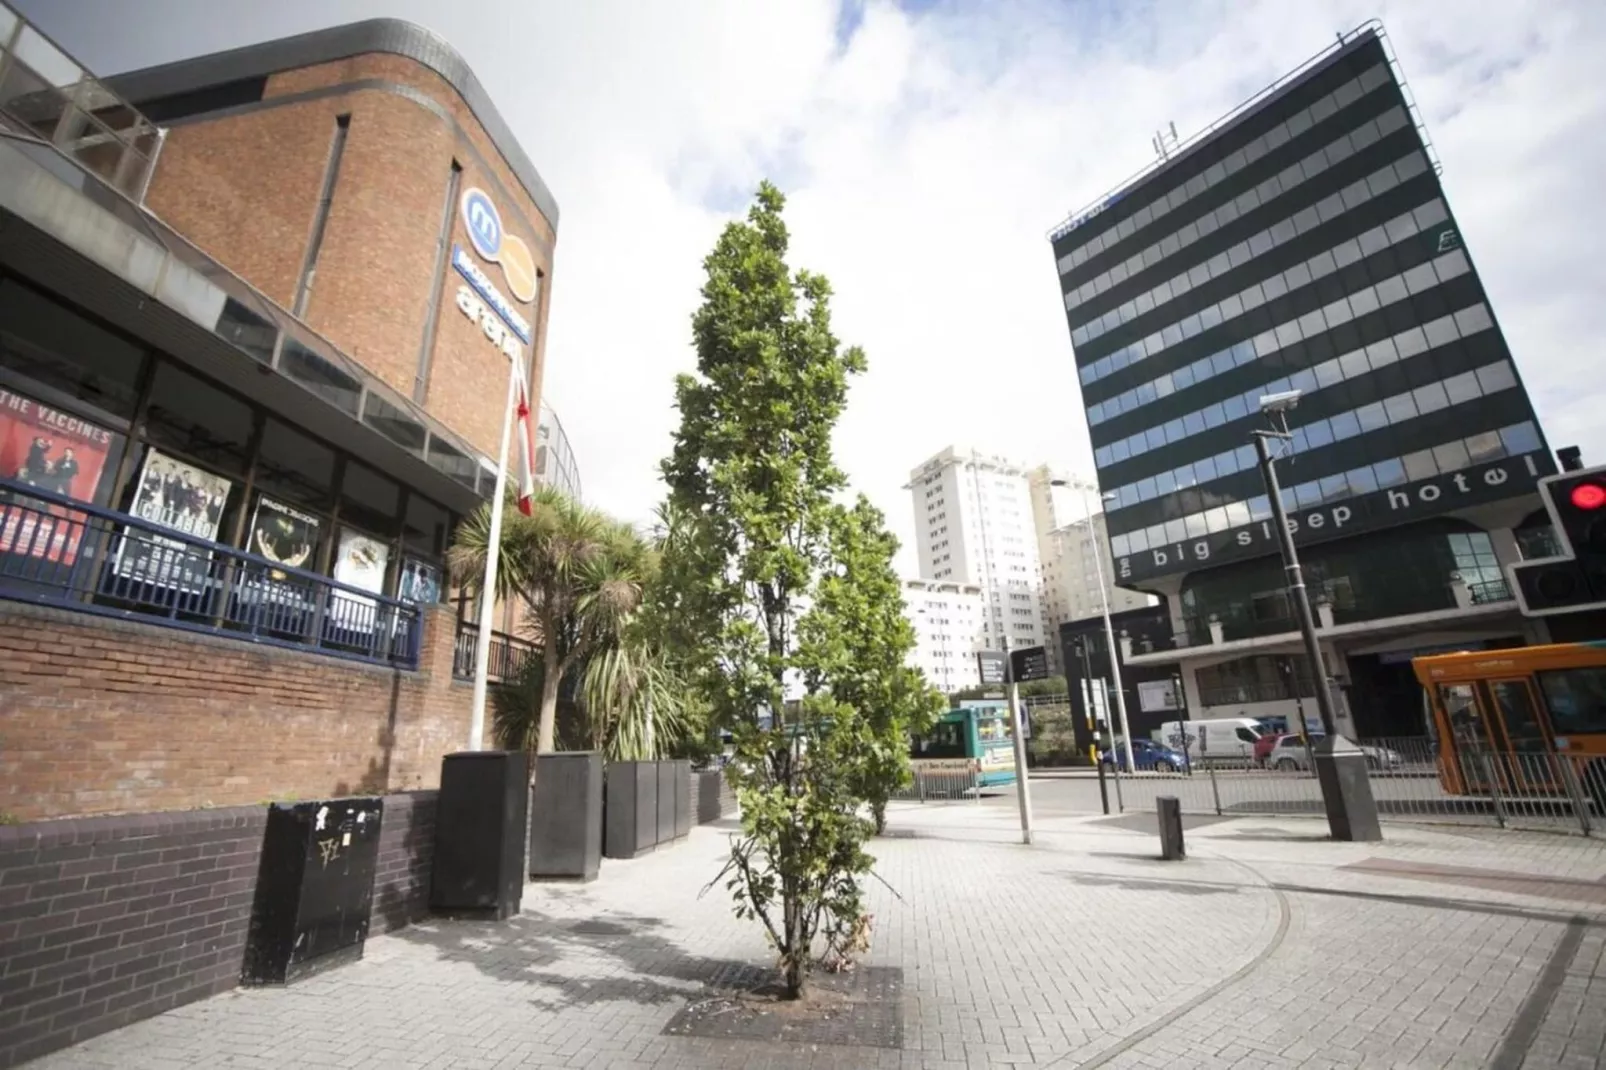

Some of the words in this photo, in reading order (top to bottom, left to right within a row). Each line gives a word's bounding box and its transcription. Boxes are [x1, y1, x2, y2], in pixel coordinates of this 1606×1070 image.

[0, 390, 31, 414] THE
[38, 404, 111, 444] VACCINES
[1119, 557, 1132, 577] the
[1153, 541, 1210, 567] big
[1236, 505, 1352, 546] sleep
[1387, 455, 1538, 510] hotel
